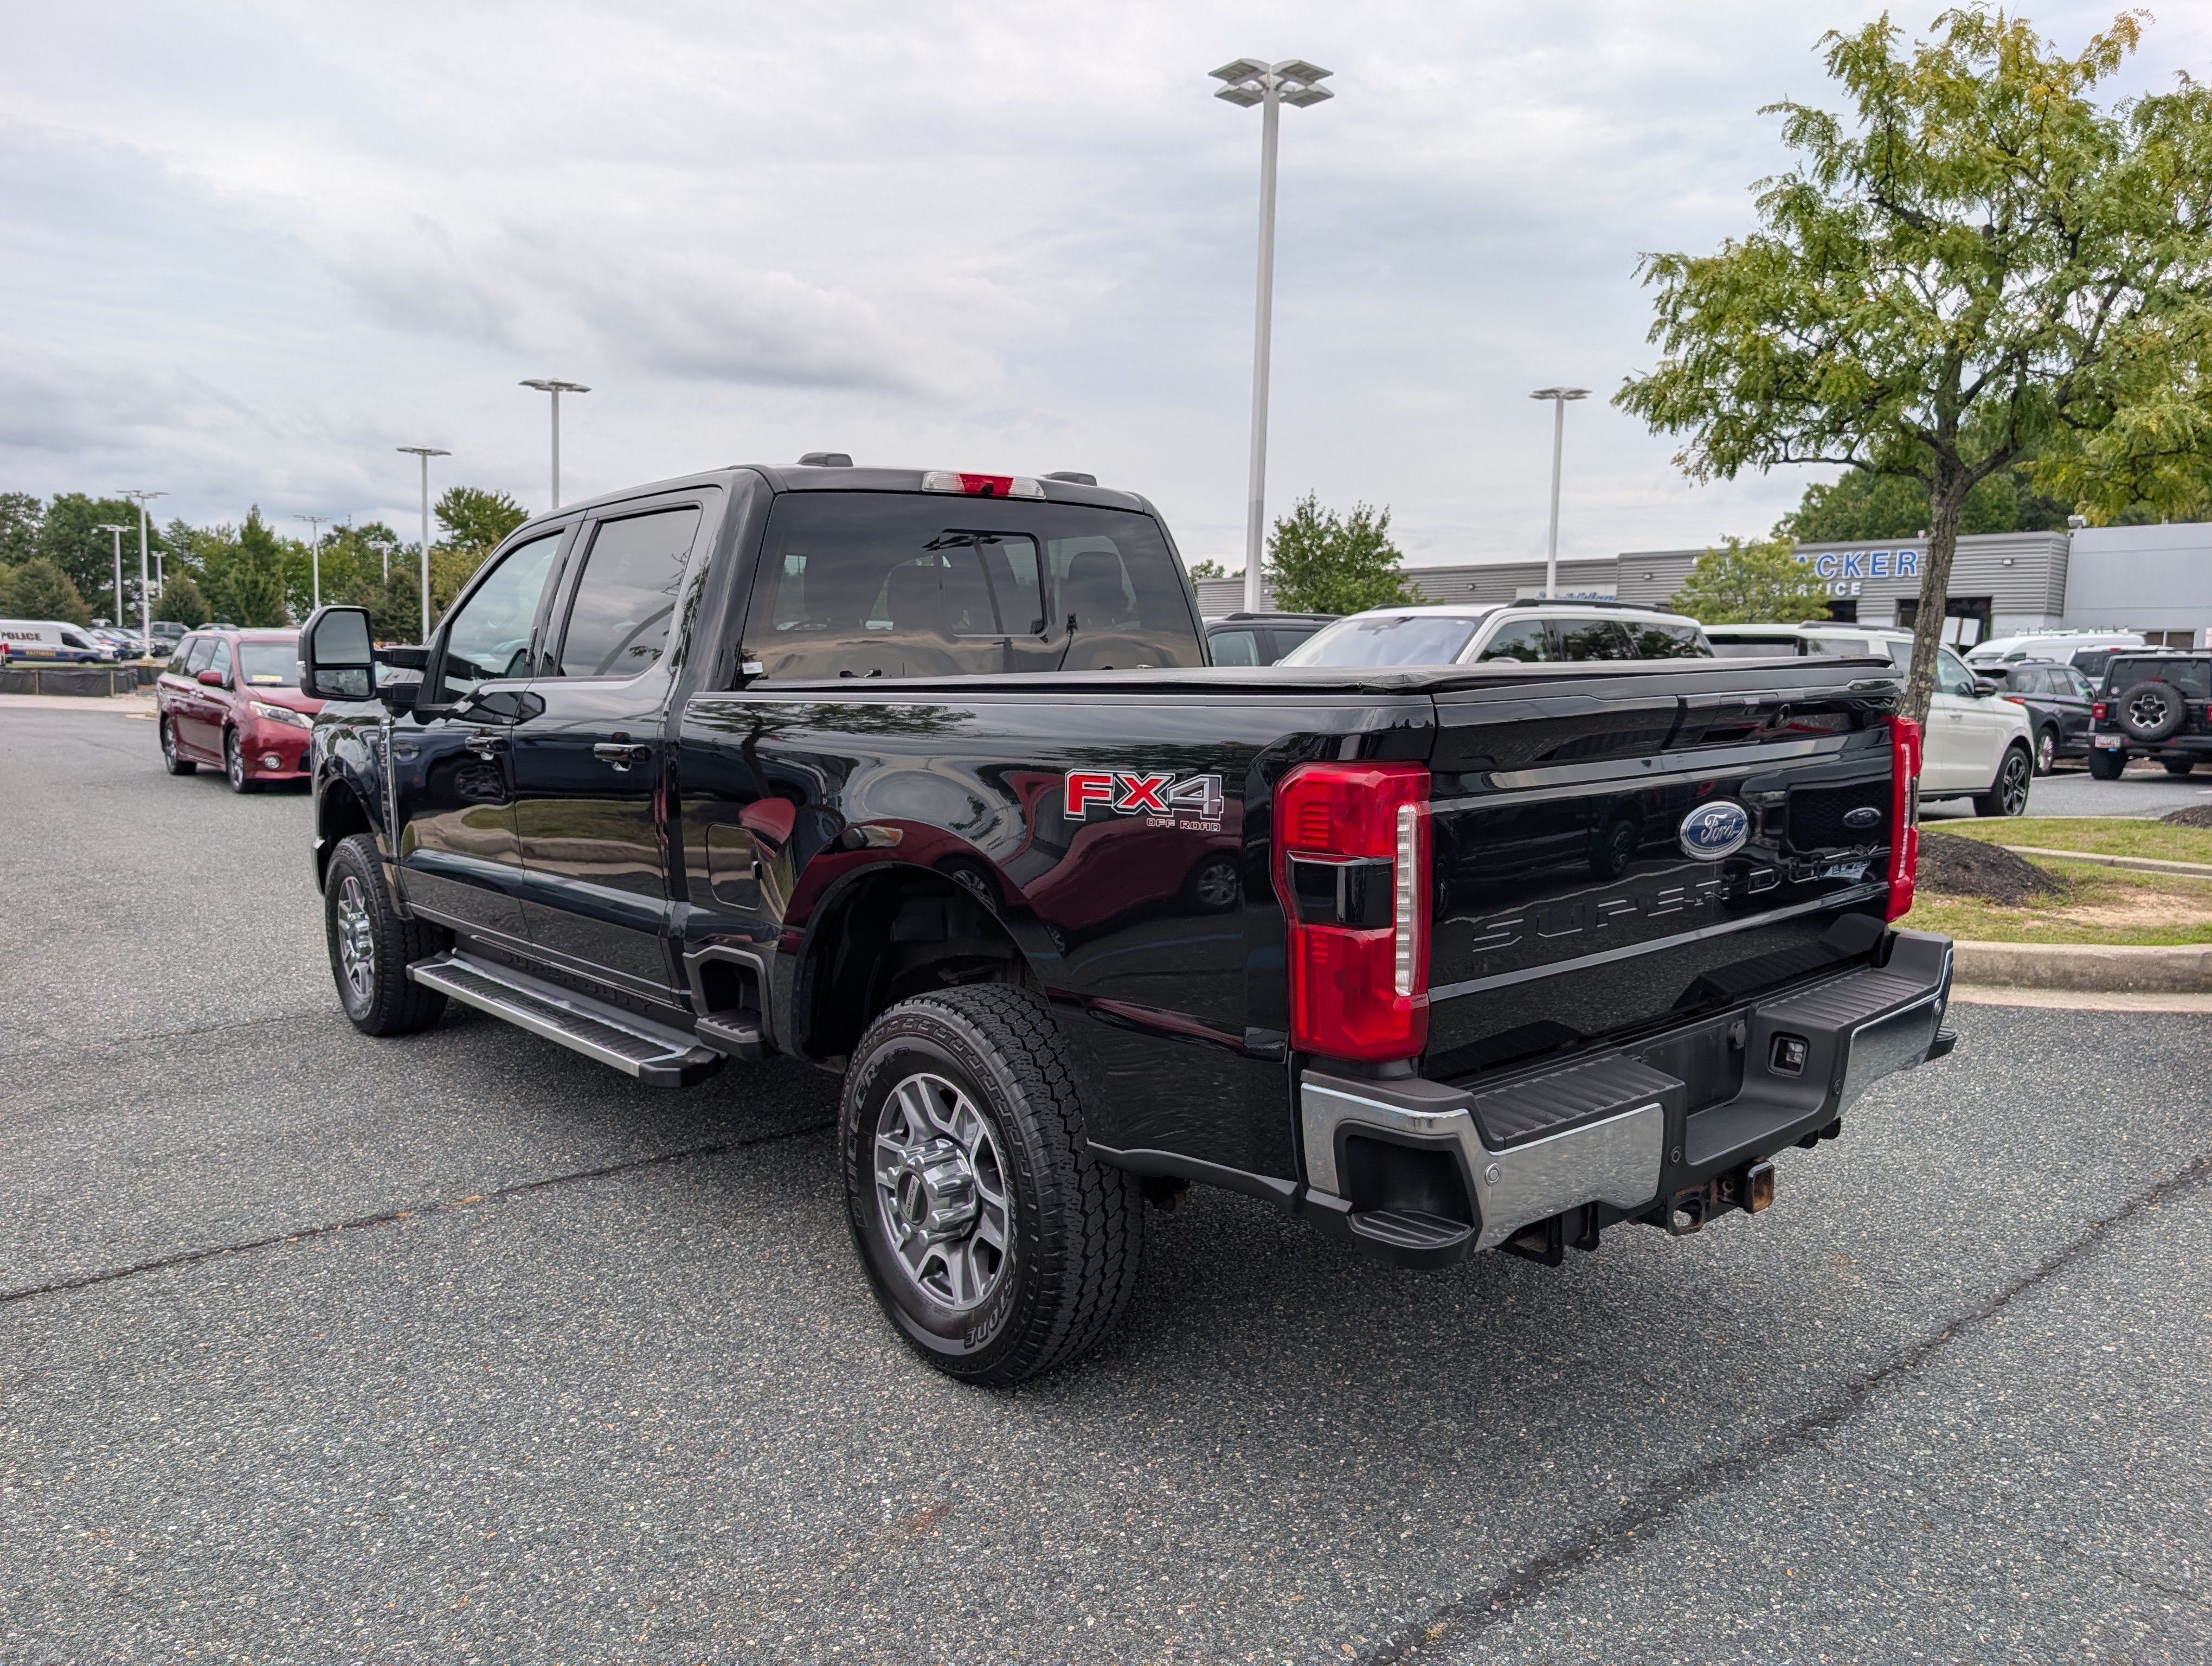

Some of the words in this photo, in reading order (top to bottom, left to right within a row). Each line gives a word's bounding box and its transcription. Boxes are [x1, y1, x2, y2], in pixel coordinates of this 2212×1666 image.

[1, 631, 42, 641] POLICE
[1064, 768, 1224, 821] FX4
[1147, 818, 1175, 828] OFF
[1180, 820, 1221, 832] ROAD
[1472, 875, 1731, 953] SUPER
